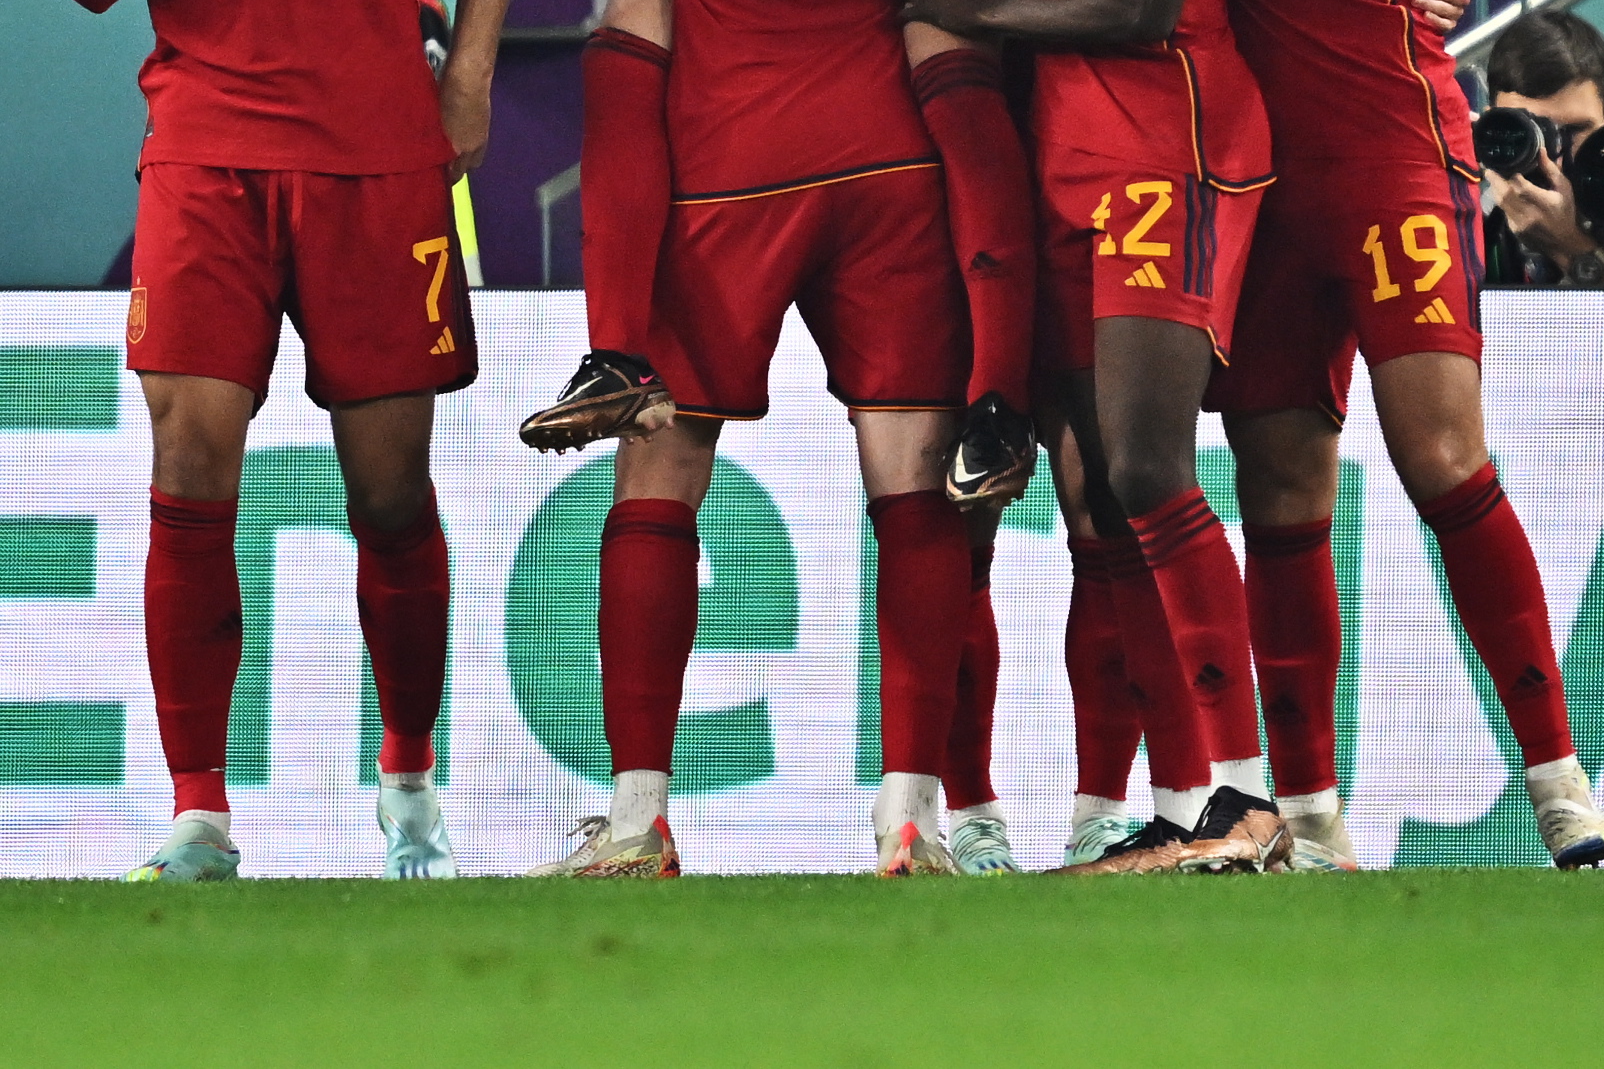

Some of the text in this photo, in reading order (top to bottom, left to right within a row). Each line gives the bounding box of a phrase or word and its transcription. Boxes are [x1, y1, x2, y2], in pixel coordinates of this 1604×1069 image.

[1091, 180, 1173, 256] 12
[1362, 213, 1453, 302] 19
[412, 235, 450, 322] 7
